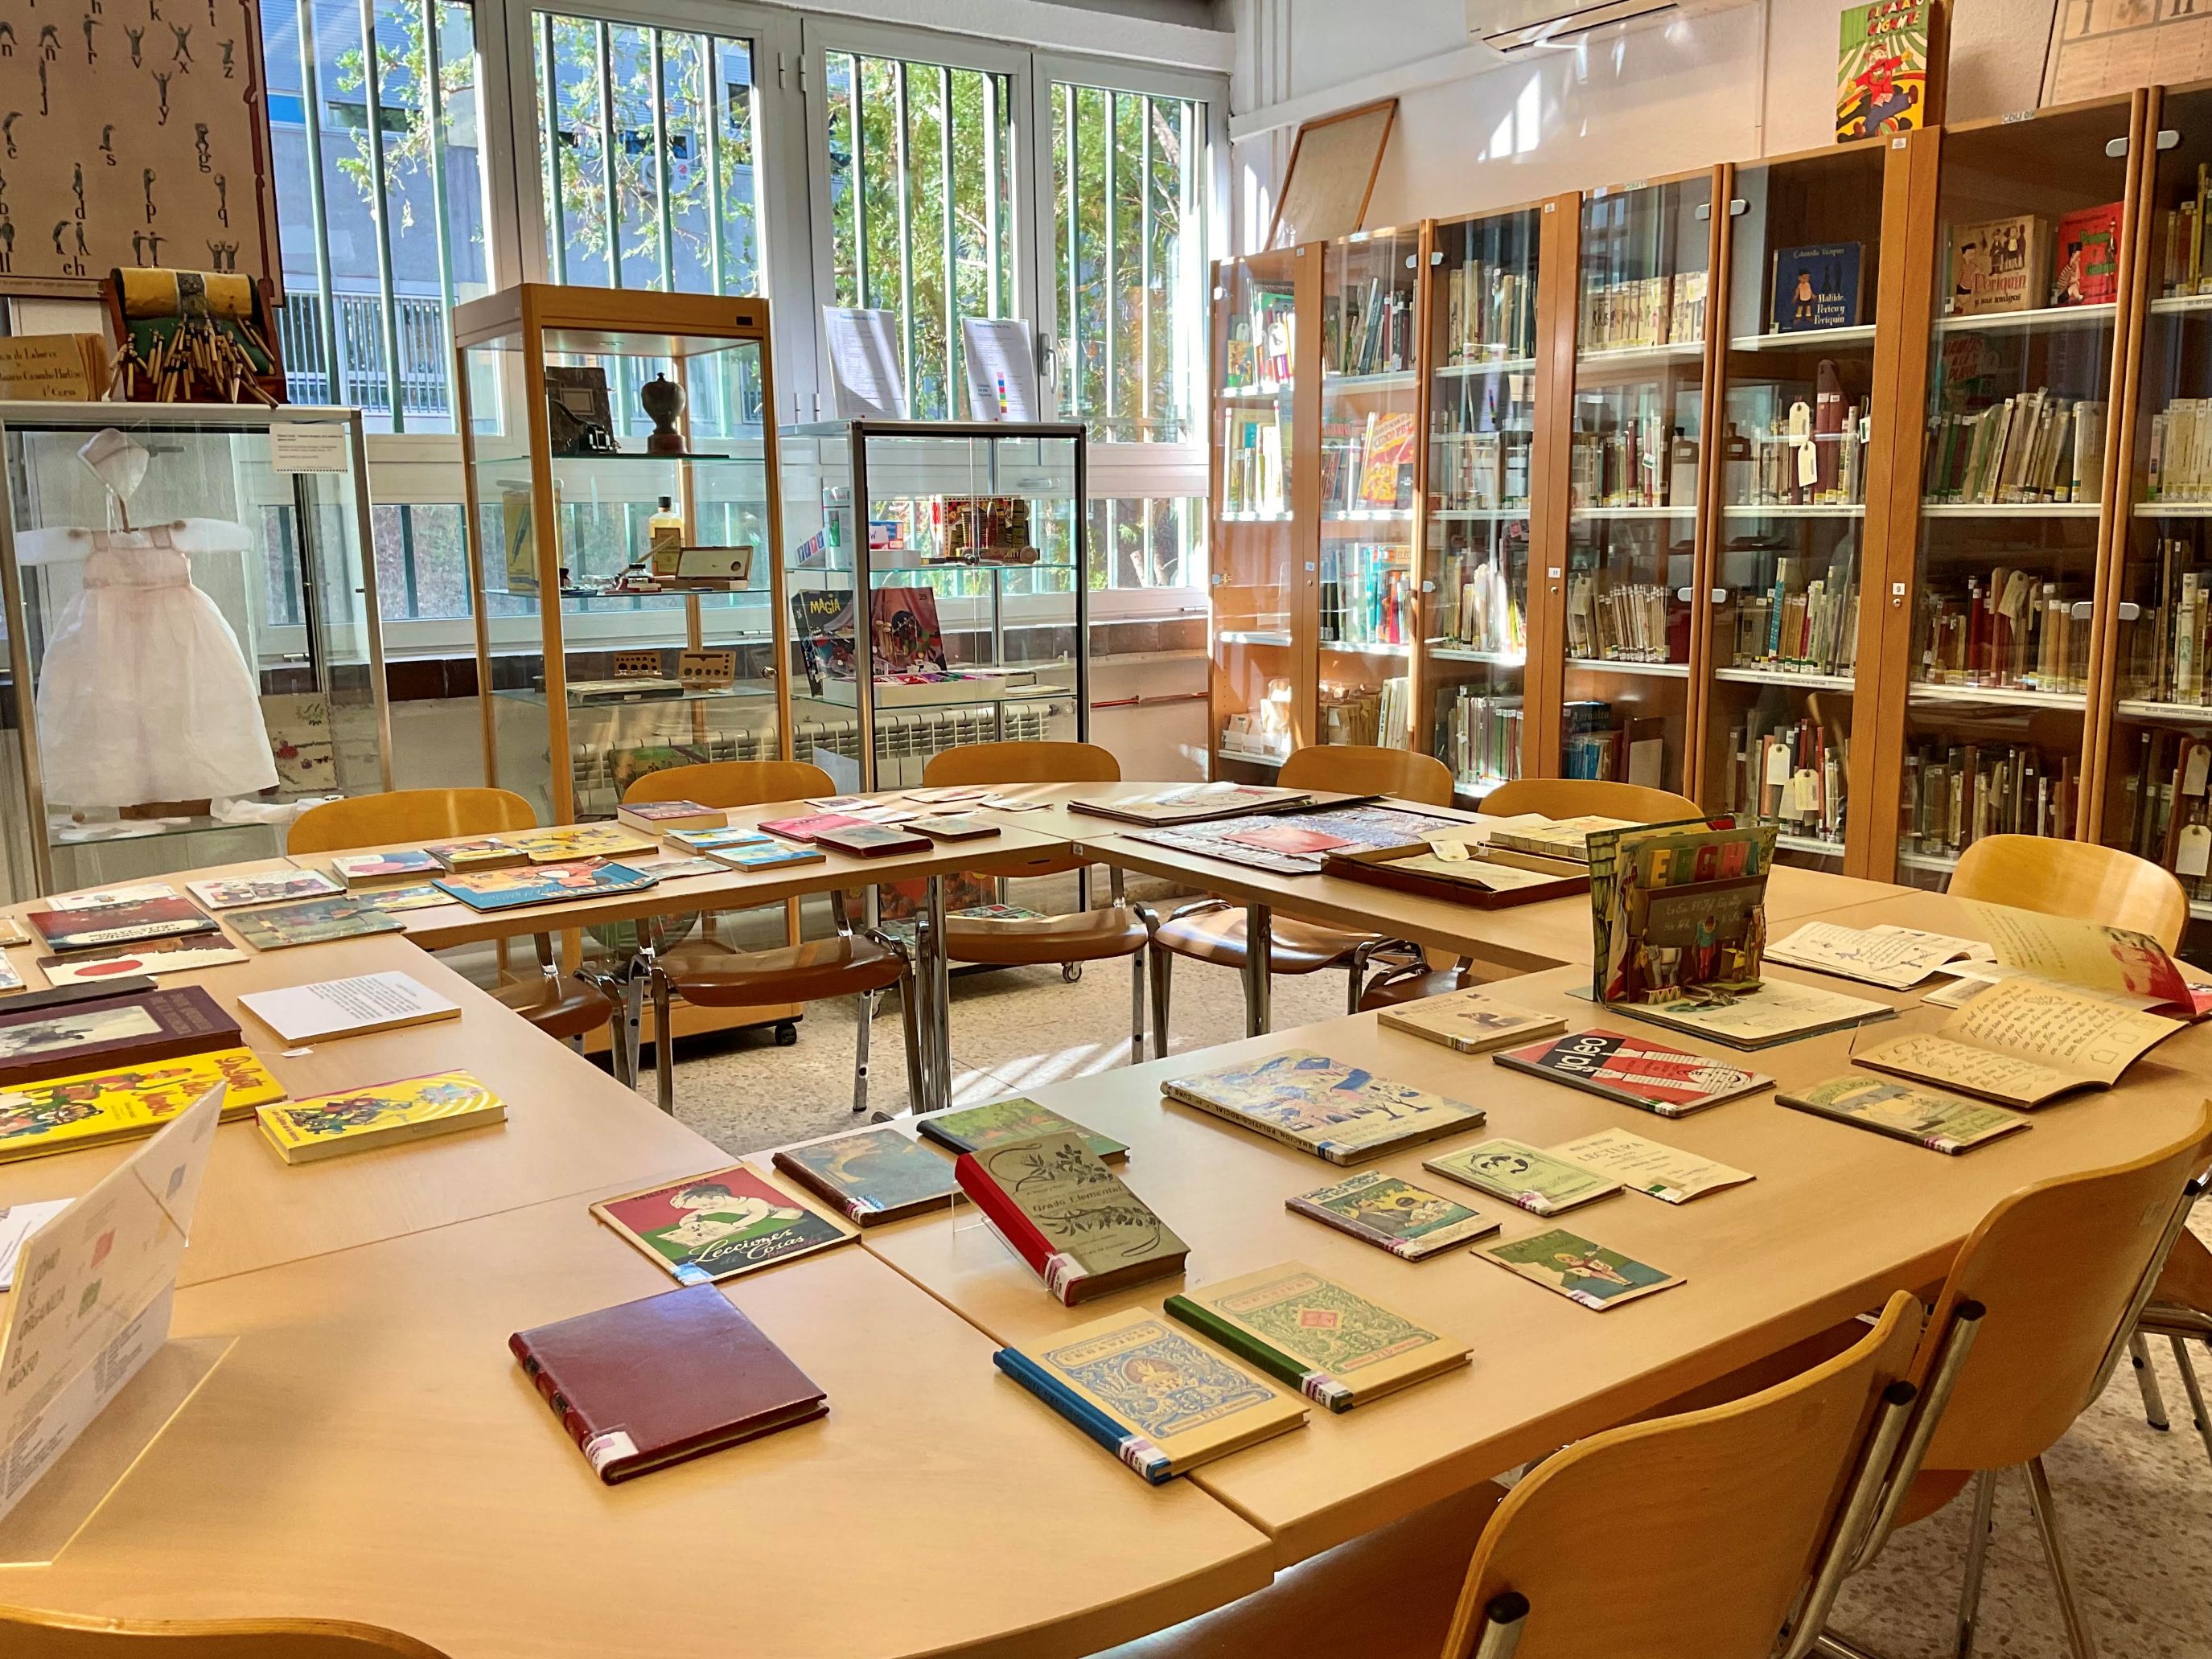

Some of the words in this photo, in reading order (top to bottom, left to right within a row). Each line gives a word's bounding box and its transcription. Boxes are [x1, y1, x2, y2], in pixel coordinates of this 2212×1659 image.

[150, 0, 162, 21] k
[2, 44, 13, 57] n
[45, 45, 56, 61] ñ
[88, 51, 97, 64] r
[179, 62, 189, 74] x
[224, 67, 233, 78] z
[158, 105, 170, 125] y
[7, 147, 17, 159] c
[106, 154, 117, 166] s
[199, 154, 212, 174] g
[75, 200, 86, 220] d
[146, 203, 157, 224] p
[217, 207, 229, 228] q
[63, 256, 86, 277] ch
[1993, 294, 2021, 304] amigos
[1577, 1142, 1643, 1162] LECTURA
[1033, 1199, 1066, 1213] Grado
[1069, 1185, 1123, 1203] Elemental
[689, 1228, 793, 1265] Lecciones
[746, 1235, 804, 1260] Cosas
